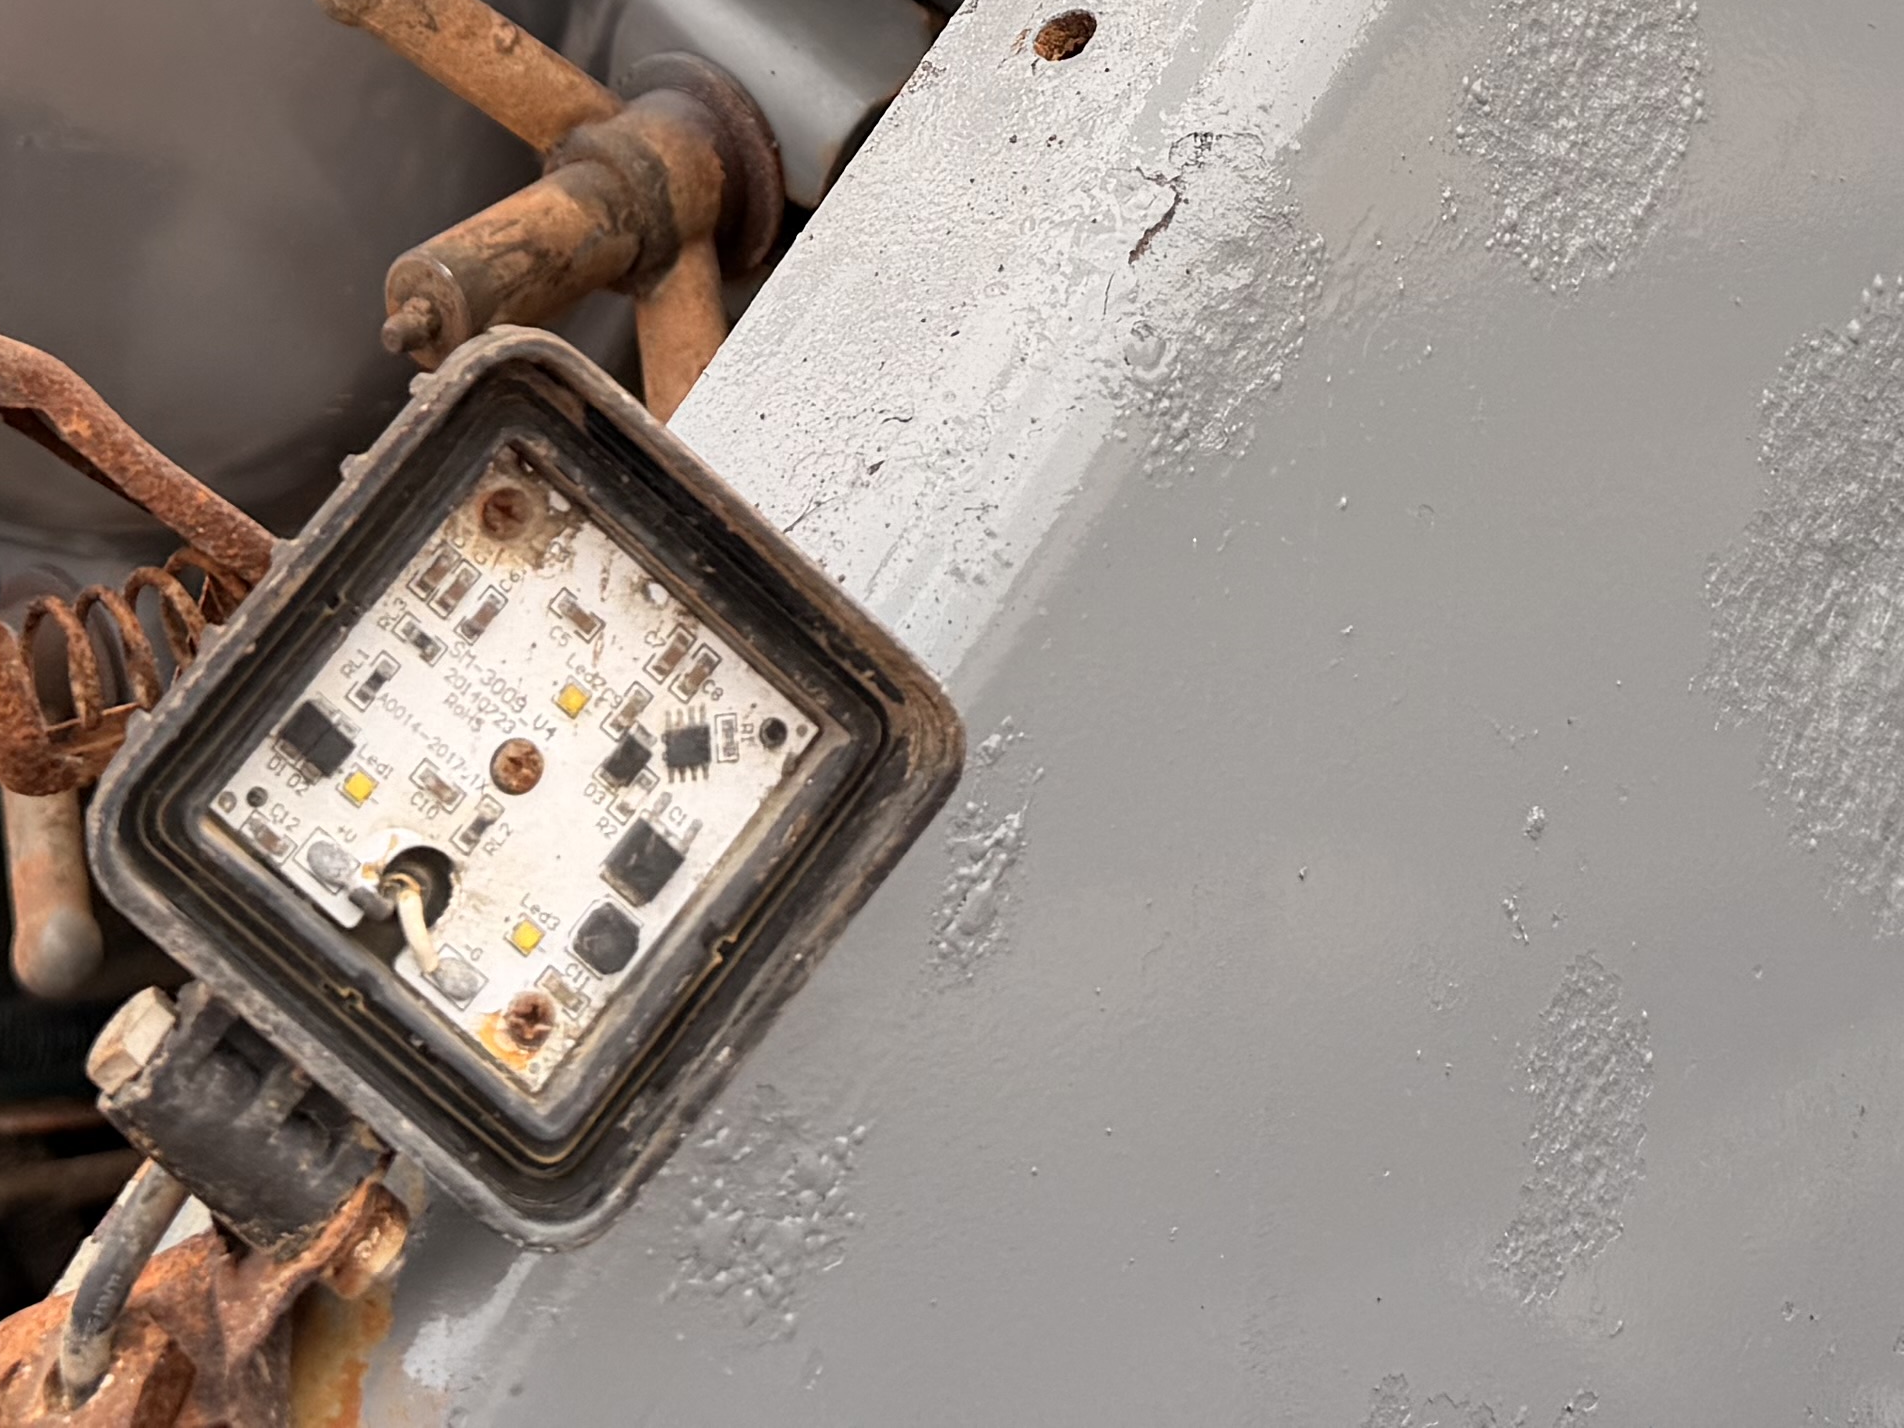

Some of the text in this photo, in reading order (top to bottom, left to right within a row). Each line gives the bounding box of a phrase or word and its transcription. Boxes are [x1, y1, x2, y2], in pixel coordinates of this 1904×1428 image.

[377, 597, 407, 631] RL3
[548, 625, 572, 648] C5
[339, 648, 371, 679] RL1
[701, 678, 725, 702] C8
[356, 743, 394, 781] Led1
[482, 821, 515, 857] RL2
[594, 815, 619, 841] R2
[519, 892, 562, 932] Led3
[563, 961, 592, 994] C11
